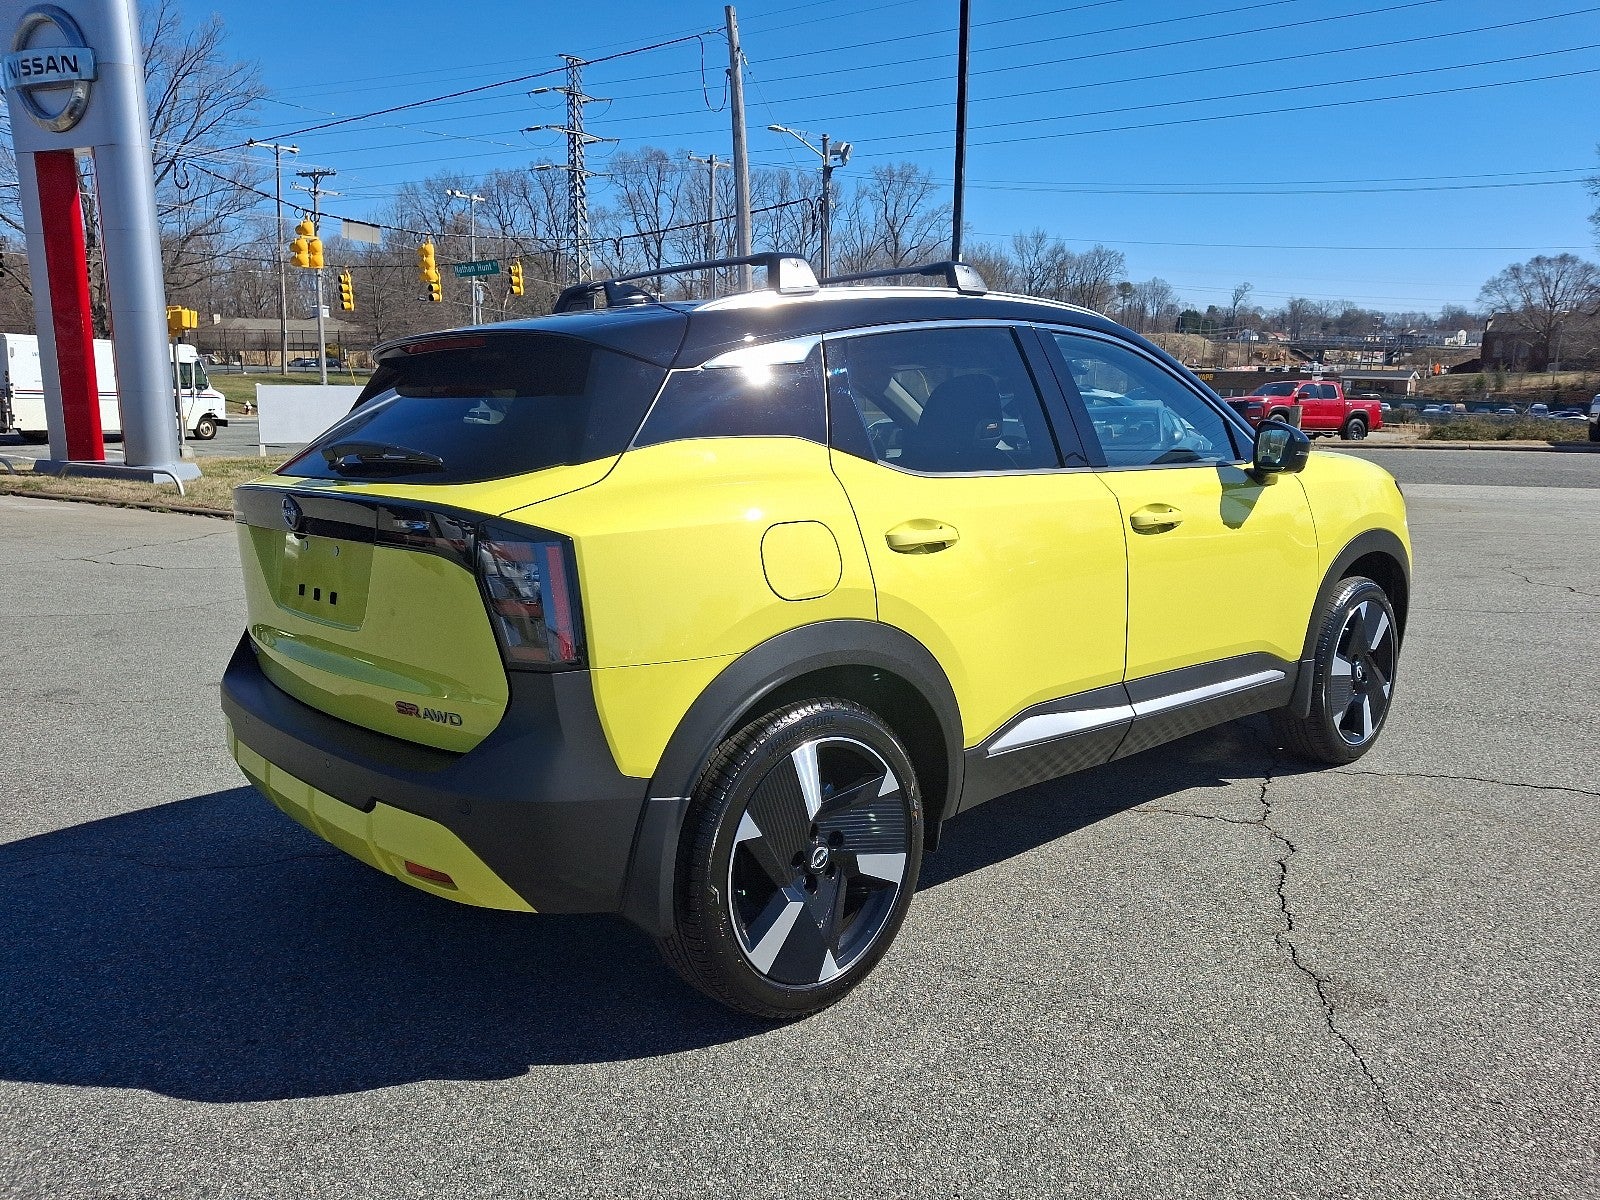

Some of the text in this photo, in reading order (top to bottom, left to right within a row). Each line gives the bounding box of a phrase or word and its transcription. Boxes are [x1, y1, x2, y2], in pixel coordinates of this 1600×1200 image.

[8, 55, 79, 79] NISSAN
[454, 264, 476, 274] Nathan
[476, 262, 493, 272] Hunt
[395, 700, 463, 727] SR AWD
